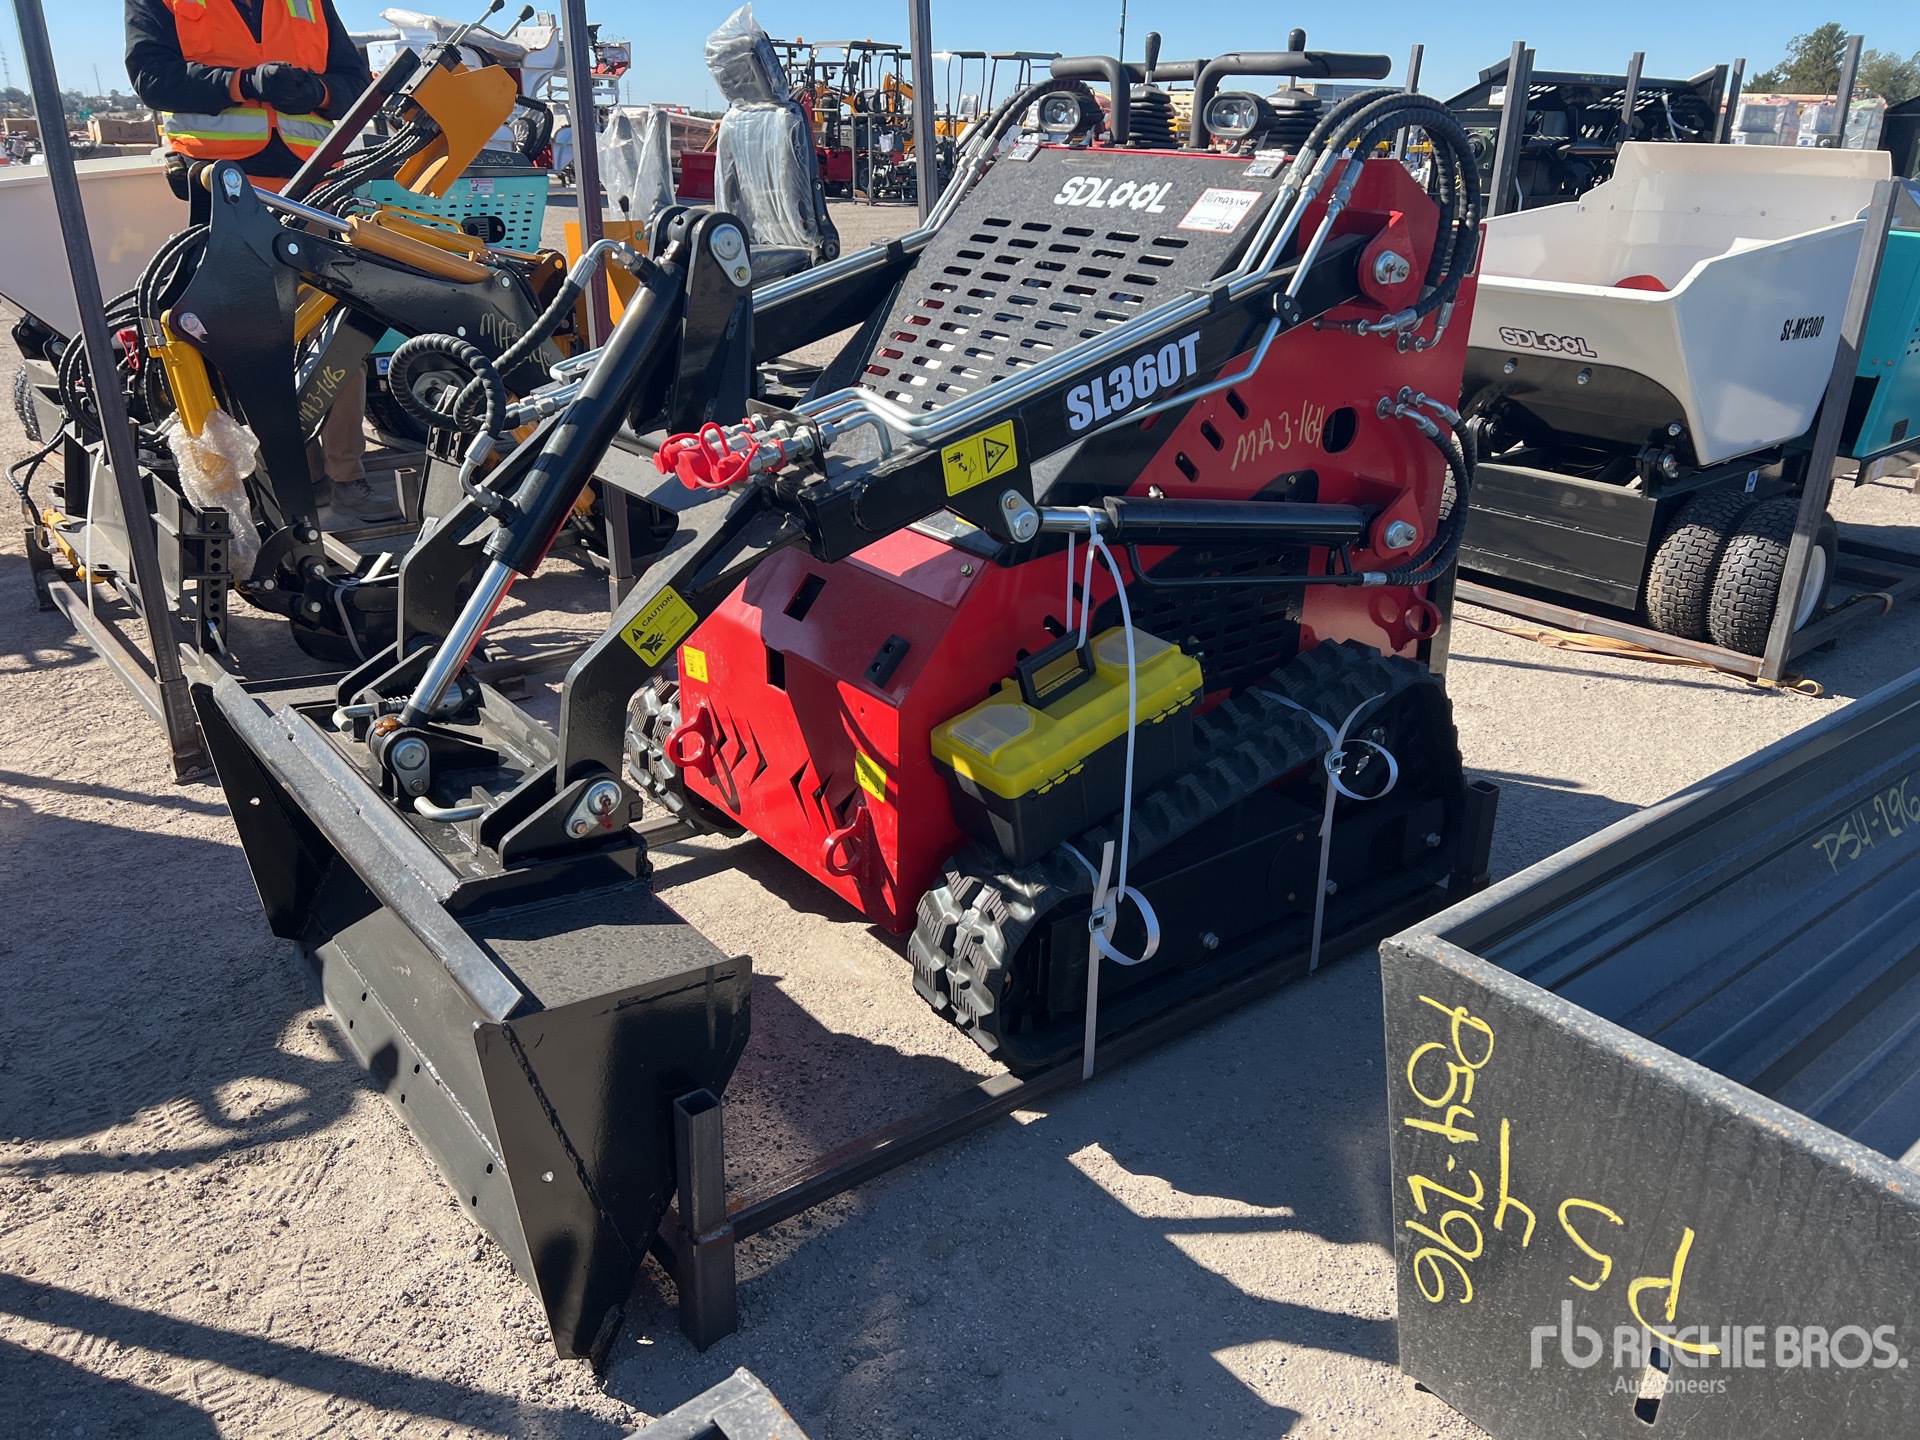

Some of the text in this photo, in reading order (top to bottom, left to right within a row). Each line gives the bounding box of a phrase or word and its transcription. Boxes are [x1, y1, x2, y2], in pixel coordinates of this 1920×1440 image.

[1054, 176, 1173, 213] SDLOOL
[1499, 326, 1598, 358] SDLOOL
[1781, 316, 1825, 341] SL-M1300
[1066, 331, 1200, 431] SL360T
[641, 594, 674, 628] CAUTION
